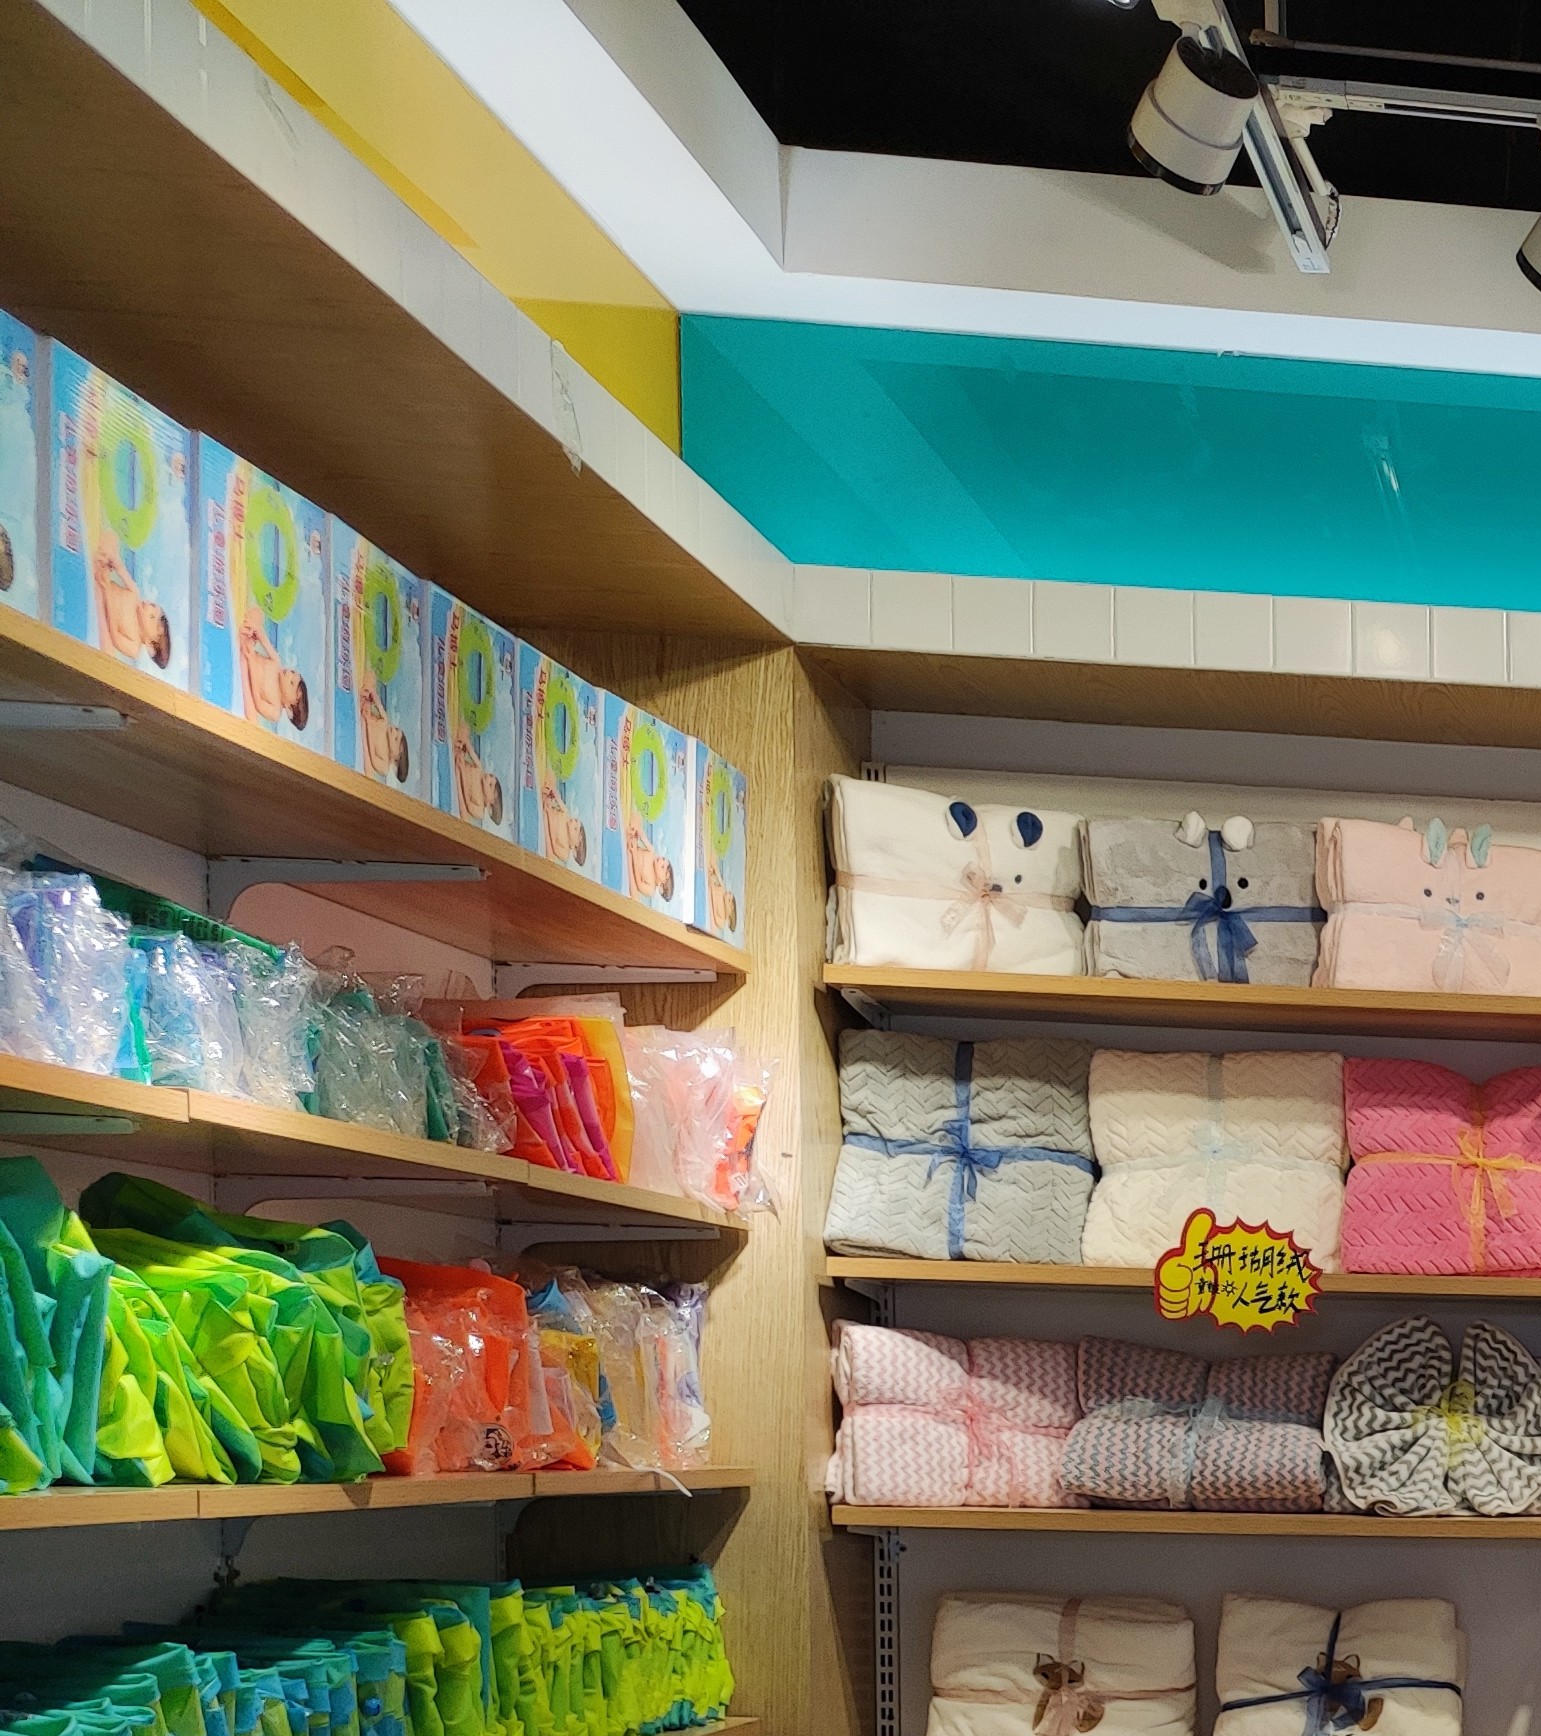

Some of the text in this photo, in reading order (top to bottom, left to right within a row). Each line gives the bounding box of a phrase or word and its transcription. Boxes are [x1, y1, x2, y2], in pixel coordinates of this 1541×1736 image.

[1193, 1241, 1313, 1283] 珊瑚绒
[1232, 1282, 1300, 1314] 人气款
